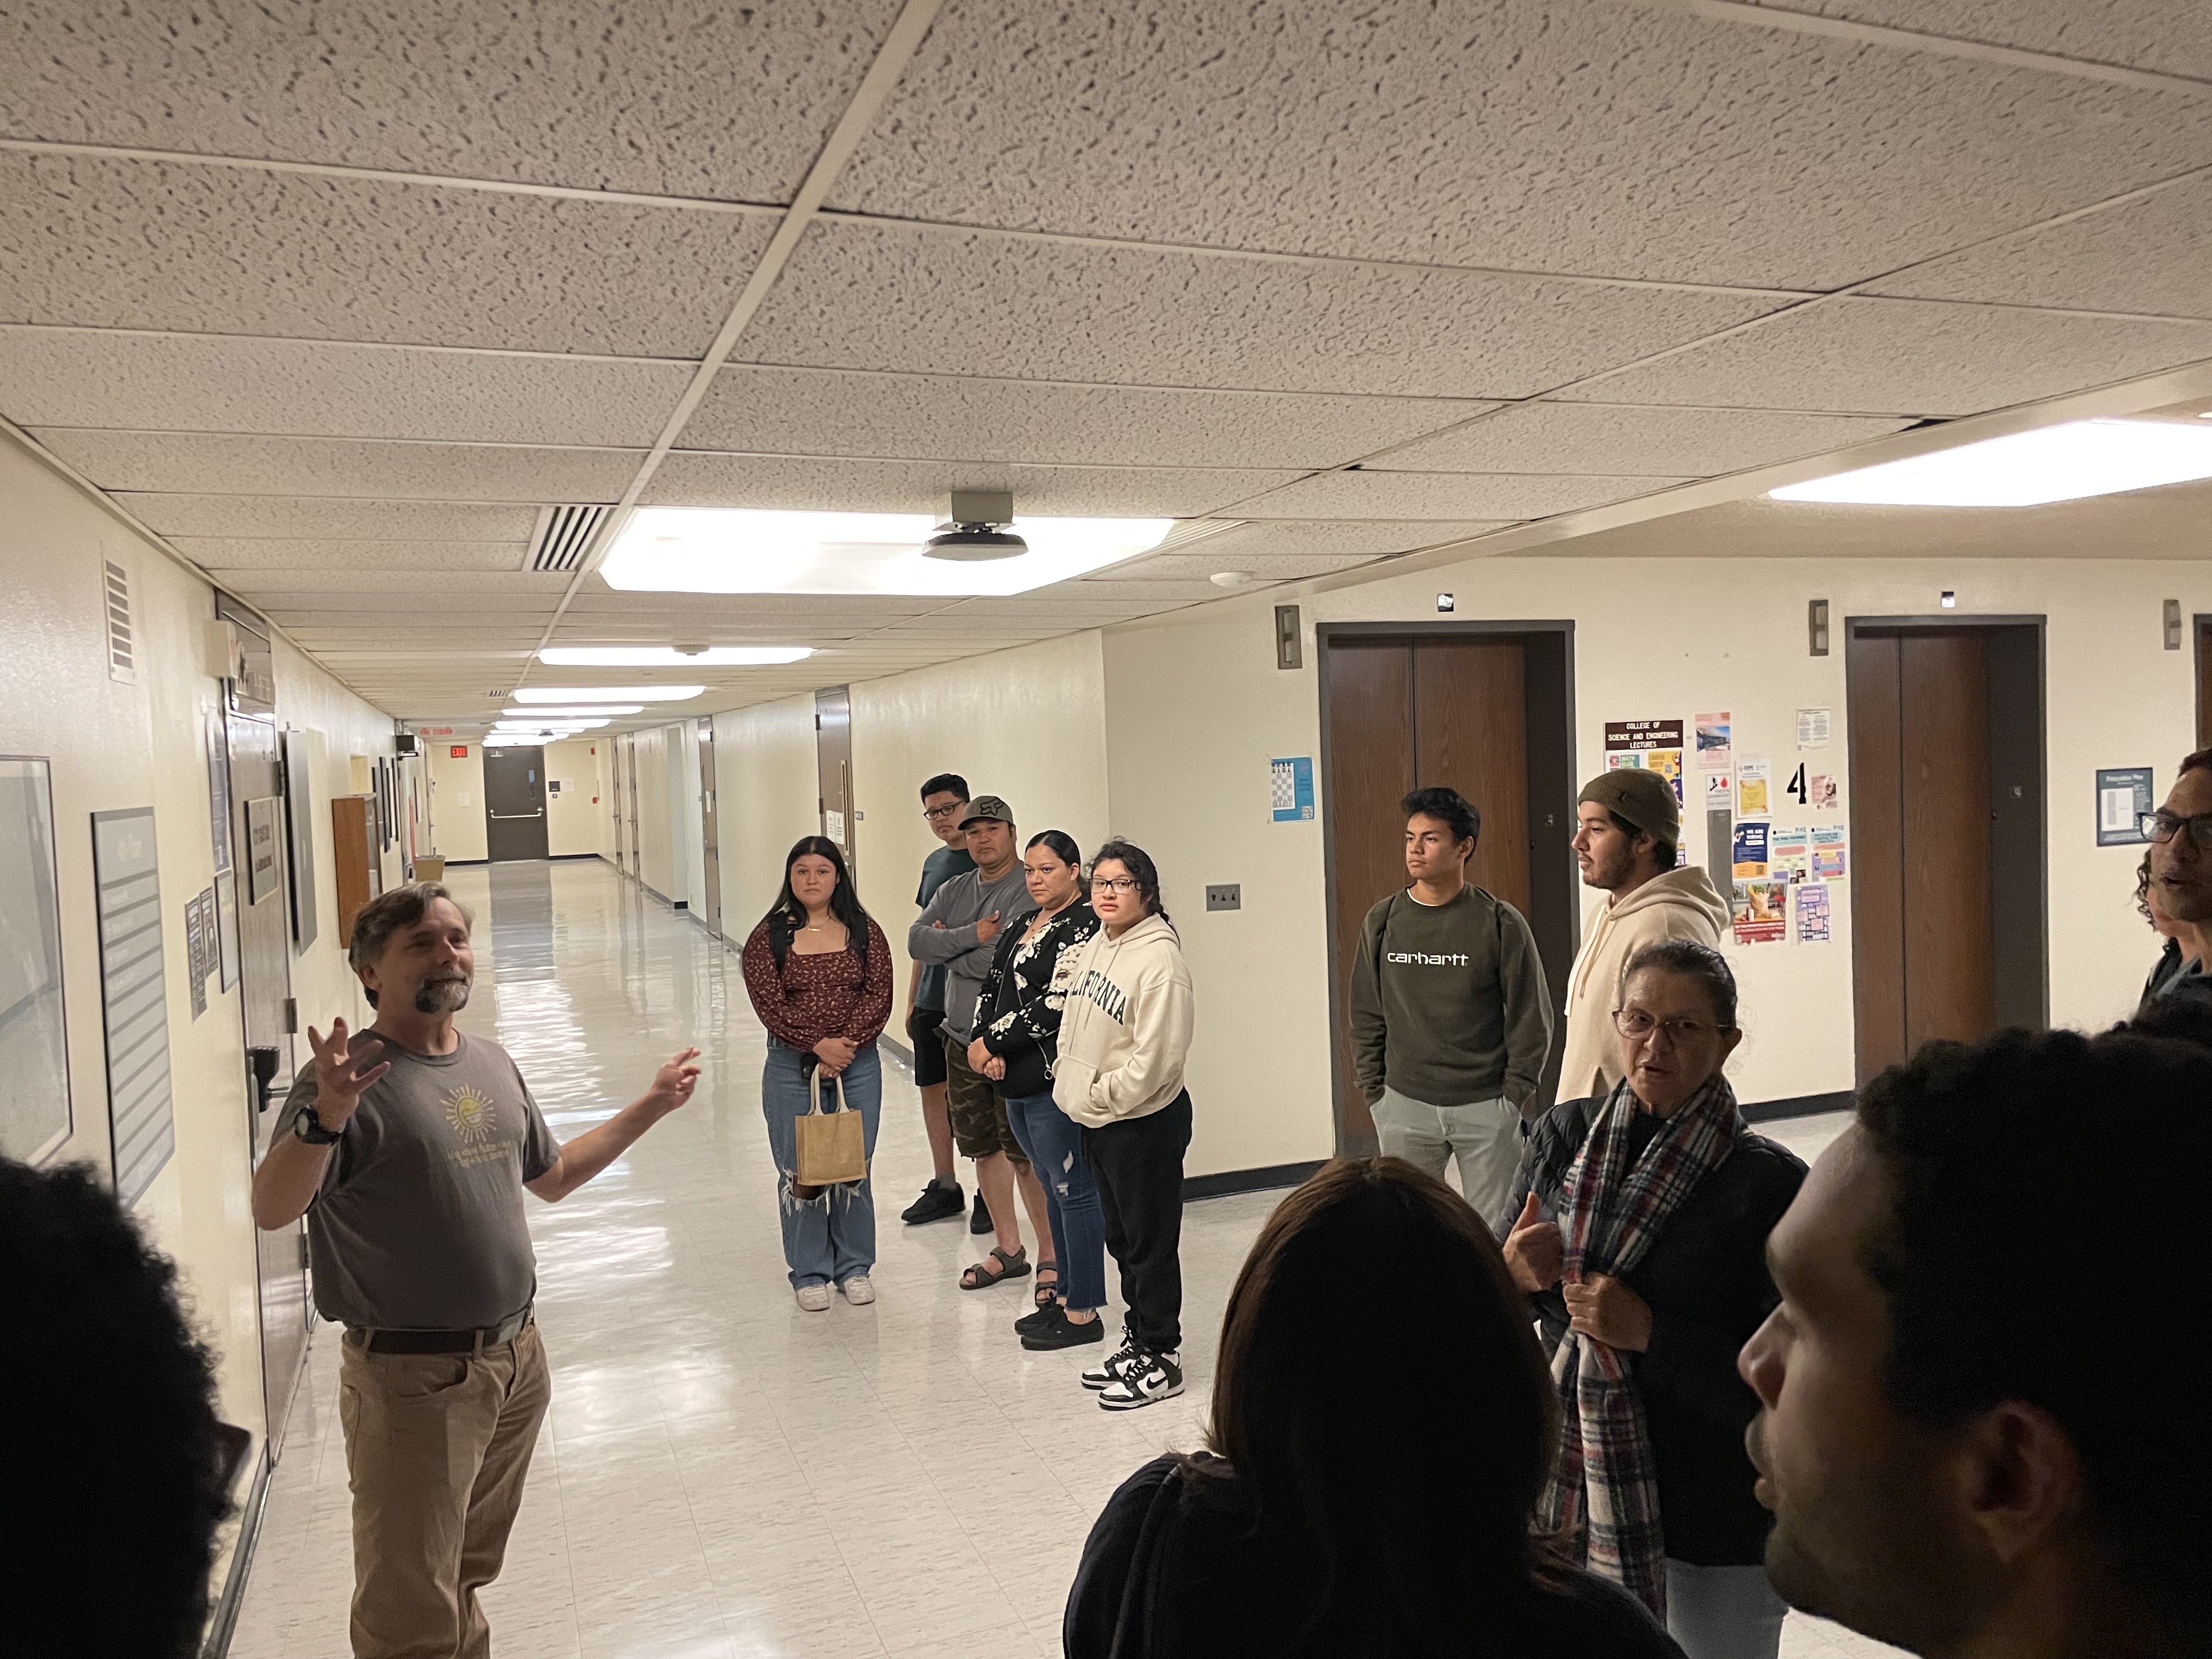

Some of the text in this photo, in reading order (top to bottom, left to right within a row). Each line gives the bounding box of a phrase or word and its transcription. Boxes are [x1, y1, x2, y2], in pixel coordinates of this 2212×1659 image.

[1646, 731, 1679, 740] ENGINEERING
[1787, 762, 1807, 804] 4
[1387, 952, 1469, 966] carhartt
[1071, 970, 1126, 1026] LIFORNIA
